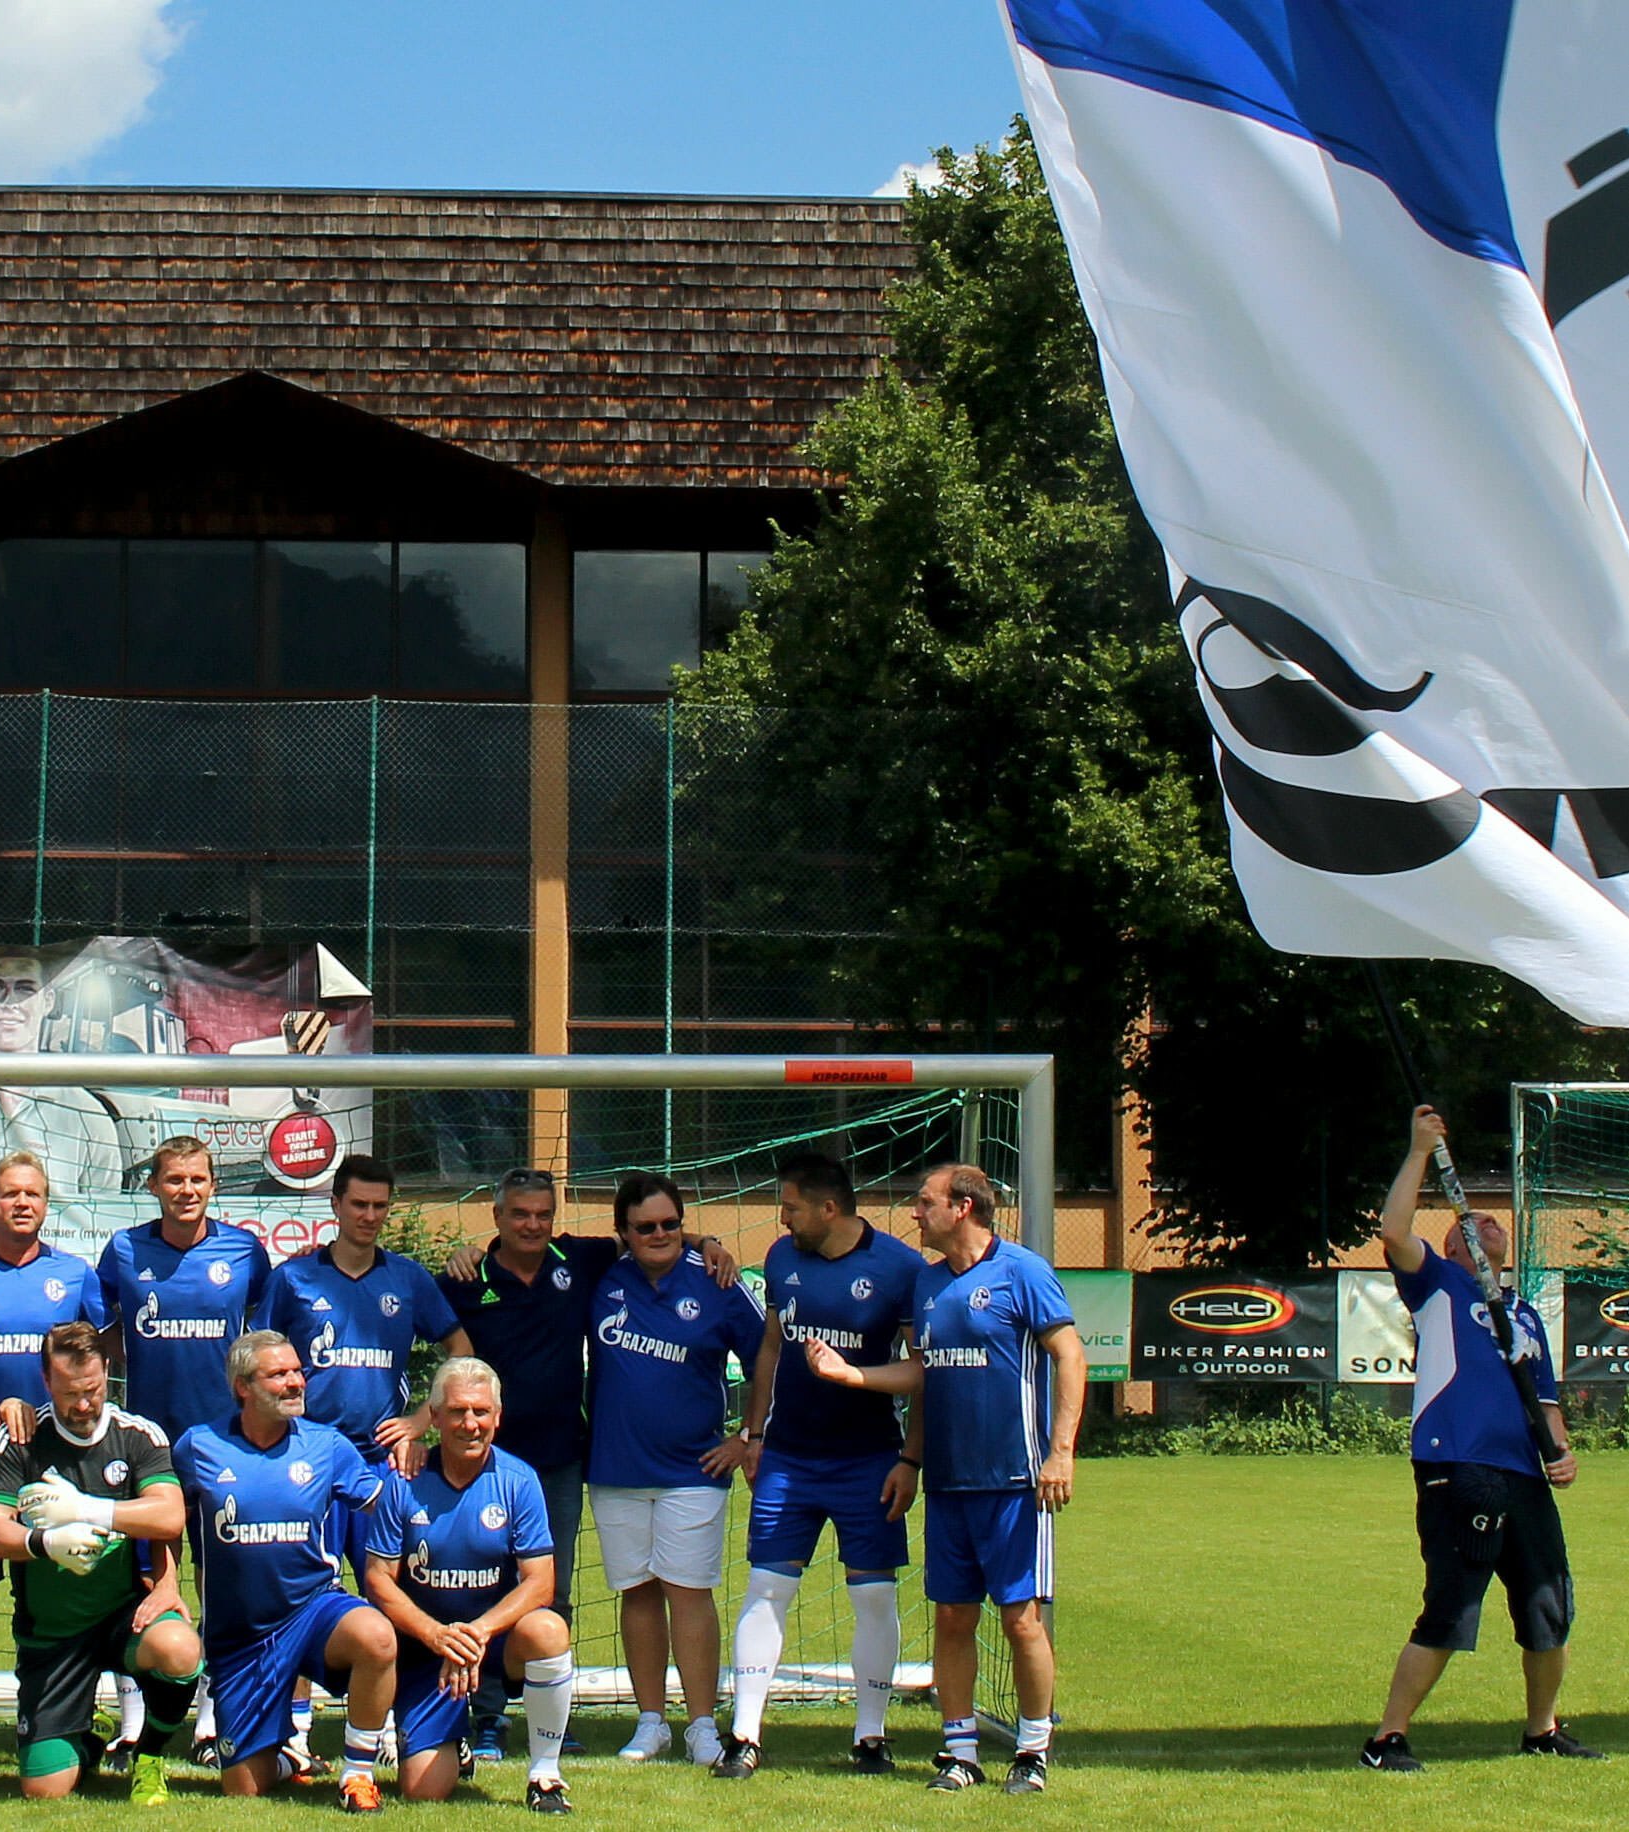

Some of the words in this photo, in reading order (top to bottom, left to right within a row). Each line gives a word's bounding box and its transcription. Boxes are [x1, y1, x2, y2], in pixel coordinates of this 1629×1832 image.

[284, 1129, 319, 1144] STARTE
[281, 1149, 327, 1165] KARRIERE
[1172, 1301, 1273, 1318] Held
[160, 1318, 228, 1339] GAZPROM
[335, 1347, 394, 1369] GAZPROM
[621, 1334, 689, 1365] GAZPROM
[932, 1347, 989, 1368] GAZPROM
[1143, 1345, 1214, 1358] BIKER
[1223, 1344, 1327, 1359] FASHION
[1193, 1361, 1291, 1375] OUTDOOR
[238, 1520, 310, 1545] GAZPROM
[430, 1565, 501, 1590] GAZPROM
[734, 1664, 768, 1676] S04
